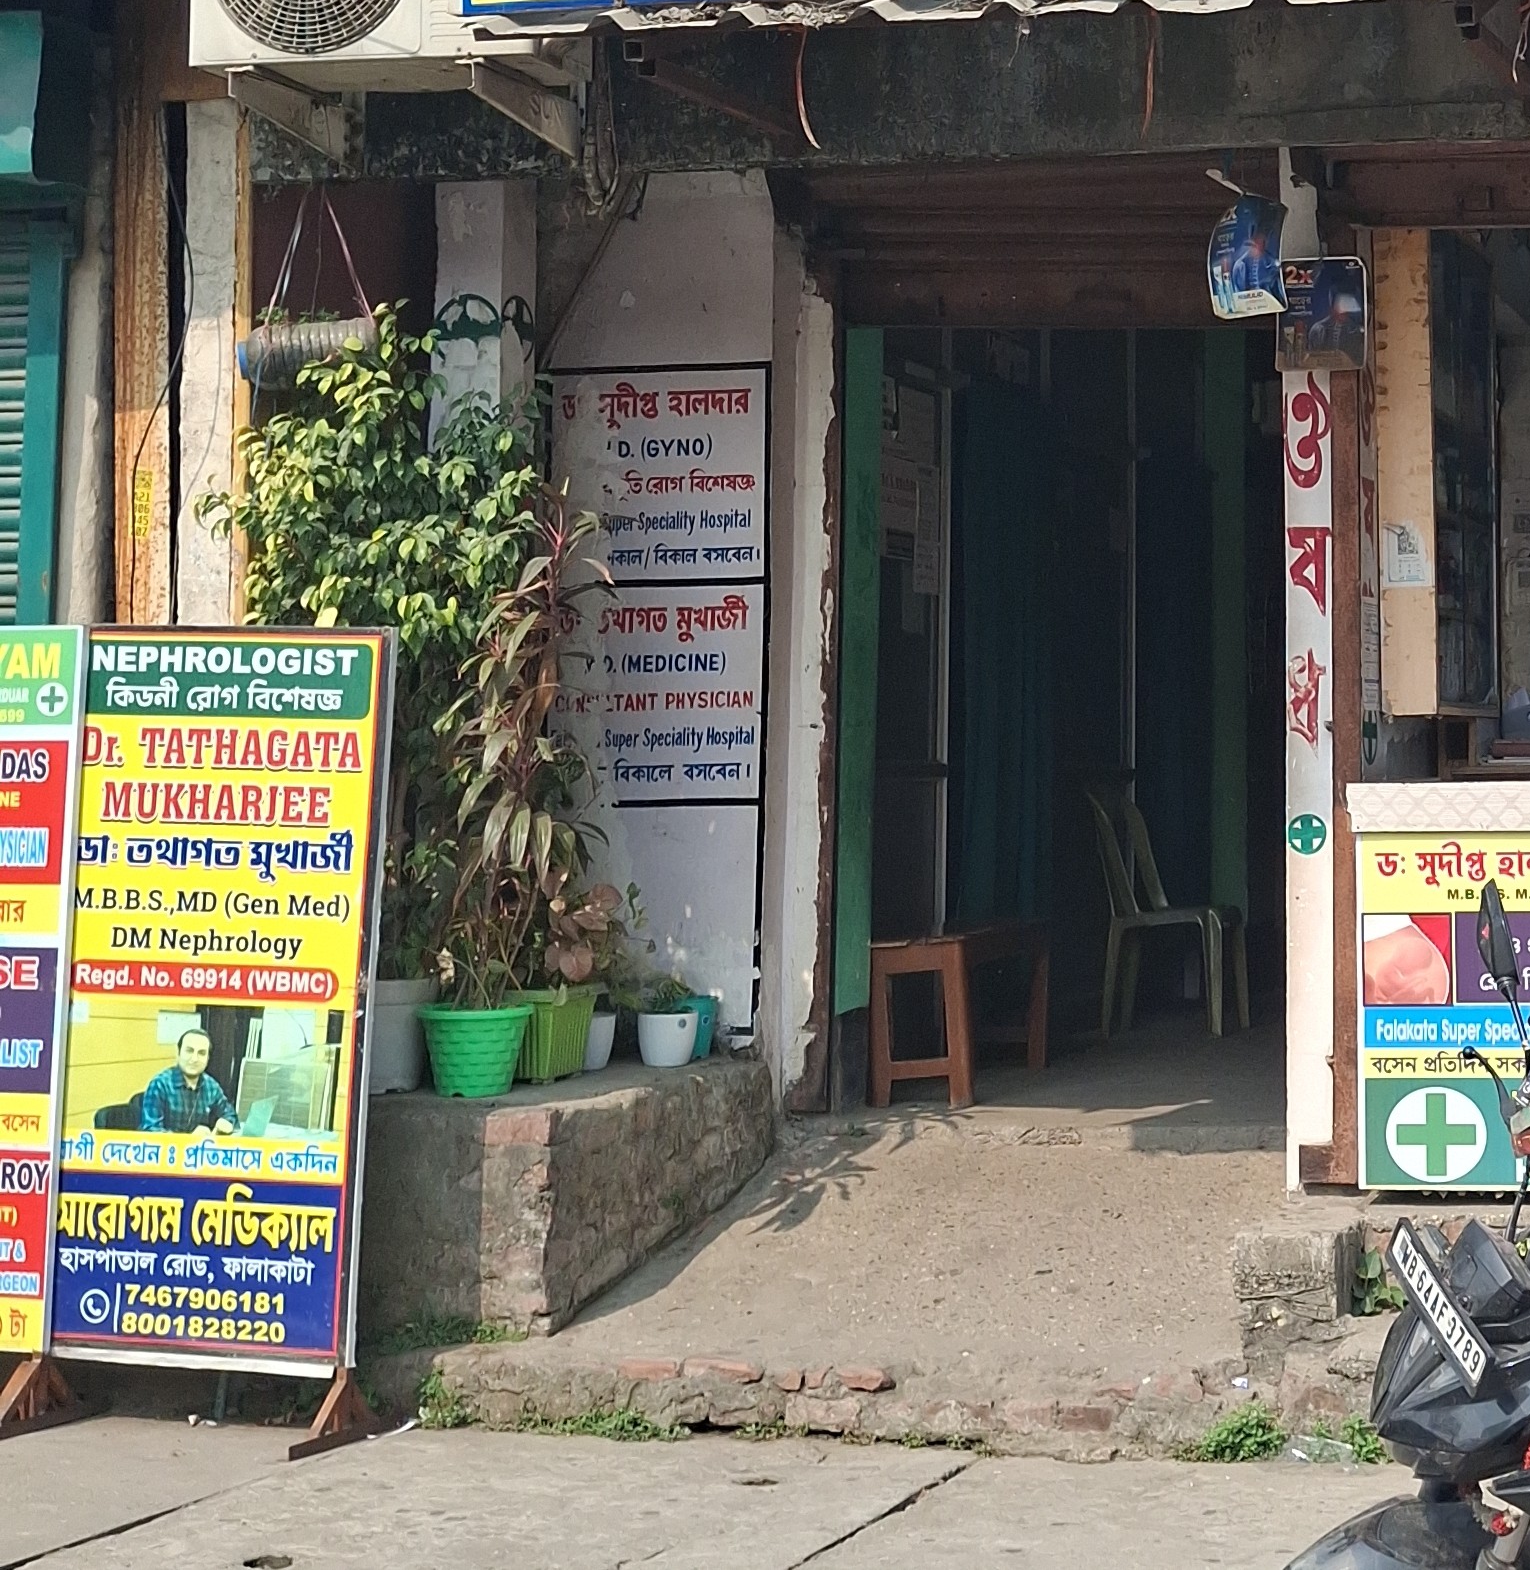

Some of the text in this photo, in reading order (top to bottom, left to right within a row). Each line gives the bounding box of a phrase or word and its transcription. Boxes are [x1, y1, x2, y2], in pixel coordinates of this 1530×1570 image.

[668, 388, 752, 417] হালদার
[641, 433, 713, 462] (GYNO)
[645, 476, 685, 495] রোগ
[689, 468, 756, 493] বিশেষজ্ঞ
[638, 511, 695, 536] Speciality
[700, 509, 751, 533] Hospital
[653, 543, 698, 565] বিকাল
[93, 644, 358, 677] NEPHROLOGIST
[622, 651, 726, 674] (MEDICINE)
[106, 677, 344, 712] কিডনী রোগ বিশেষজ্ঞ
[665, 691, 753, 710] PHYSICIAN
[83, 725, 363, 771] Dr. TATHAGATA
[605, 729, 639, 753] Super
[643, 727, 703, 753] Speciality
[707, 725, 755, 751] Hospital
[2, 752, 47, 780] DAS
[613, 758, 674, 783] বিকালে
[0, 791, 20, 806] NE
[101, 781, 331, 827] MUKHARJEE
[0, 830, 46, 864] YSICIAN
[126, 836, 242, 869] তথাগত
[249, 830, 354, 883] মুখার্জী
[1415, 842, 1487, 887] সুদীপ্ত
[225, 891, 280, 918] (Gen
[288, 894, 350, 922] Med)
[112, 927, 302, 958] DM Nephrology
[75, 966, 333, 998] Regd. No. 69914 (WBMC)
[1376, 1019, 1437, 1041] Falakata
[1441, 1020, 1482, 1044] Super
[1, 1040, 42, 1067] LIST
[1371, 1057, 1417, 1073] বসেন
[1, 1113, 40, 1132] বসেন
[102, 1140, 338, 1174] দেখেন প্রতিমাসে একদিন
[2, 1163, 48, 1192] ROY
[192, 1183, 336, 1253] মেডিক্যাল
[59, 1246, 159, 1275] হাসপাতাল
[222, 1256, 316, 1285] ফালাকাটা
[0, 1274, 38, 1293] GEON
[125, 1285, 284, 1314] 7467906181
[121, 1313, 285, 1343] 8001828220
